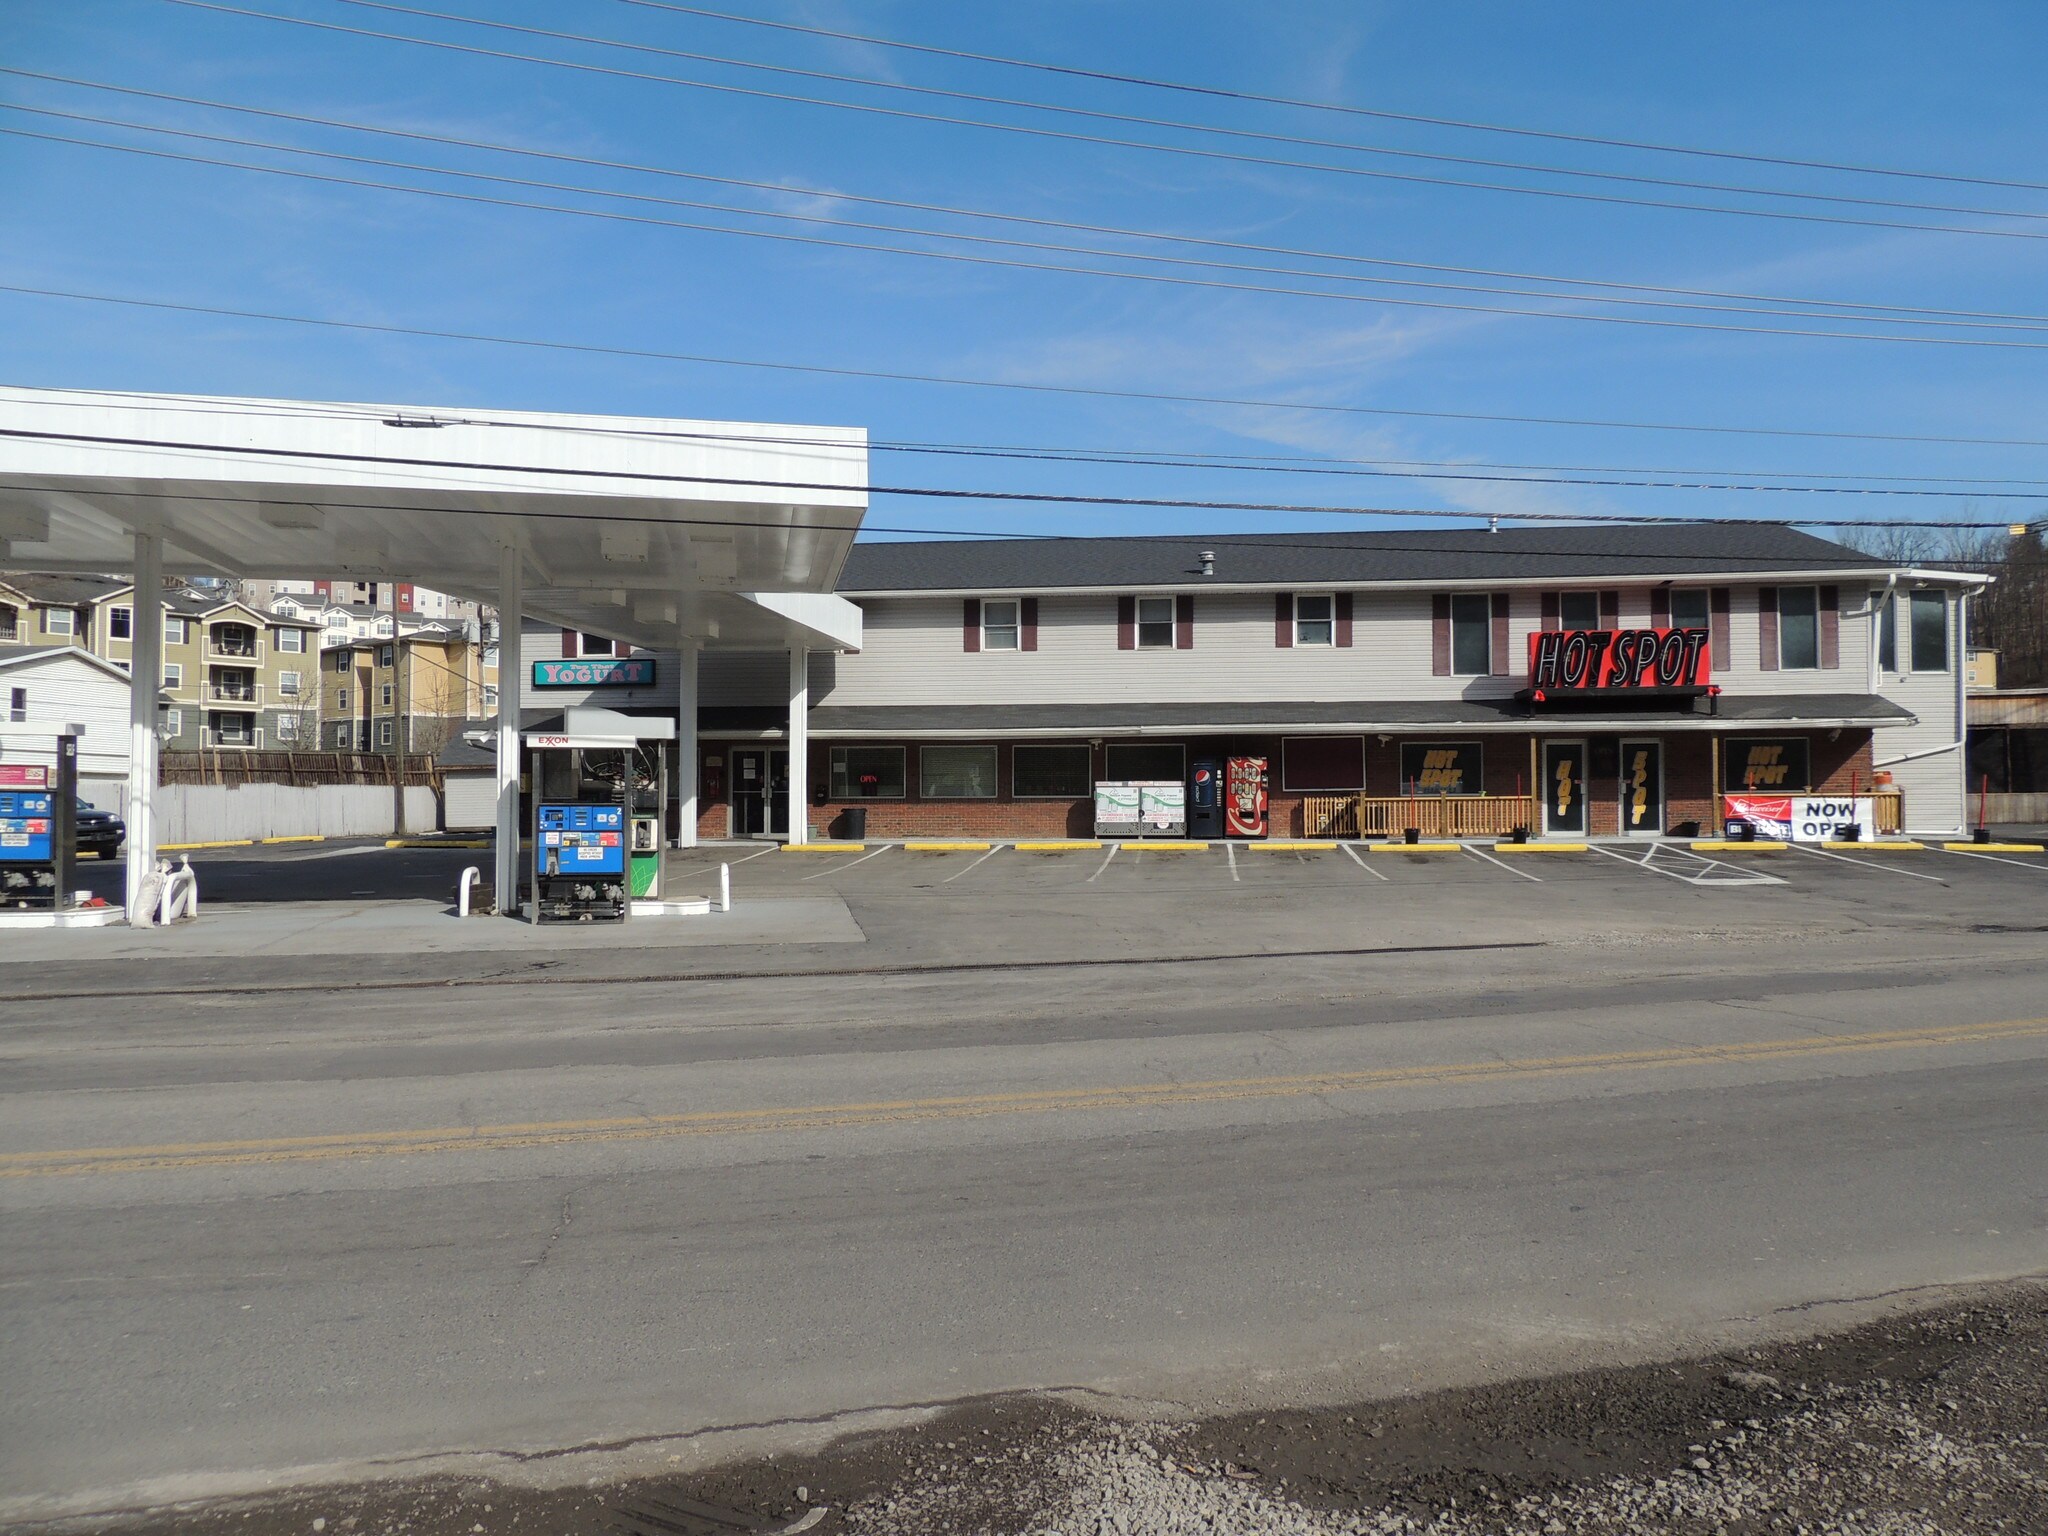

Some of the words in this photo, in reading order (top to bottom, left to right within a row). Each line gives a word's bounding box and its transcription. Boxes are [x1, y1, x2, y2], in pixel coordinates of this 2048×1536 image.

[1533, 631, 1612, 688] HOT
[1606, 628, 1709, 687] SPOT
[538, 736, 569, 746] EXXON
[1423, 750, 1458, 769] HOT
[1748, 745, 1784, 765] HOT
[860, 775, 877, 783] OPEN
[1420, 768, 1463, 788] SPOT
[1743, 764, 1788, 785] SPOT
[1556, 760, 1572, 816] HOT
[1631, 750, 1648, 825] SPOT
[616, 807, 622, 815] 2
[1806, 803, 1857, 817] NOW
